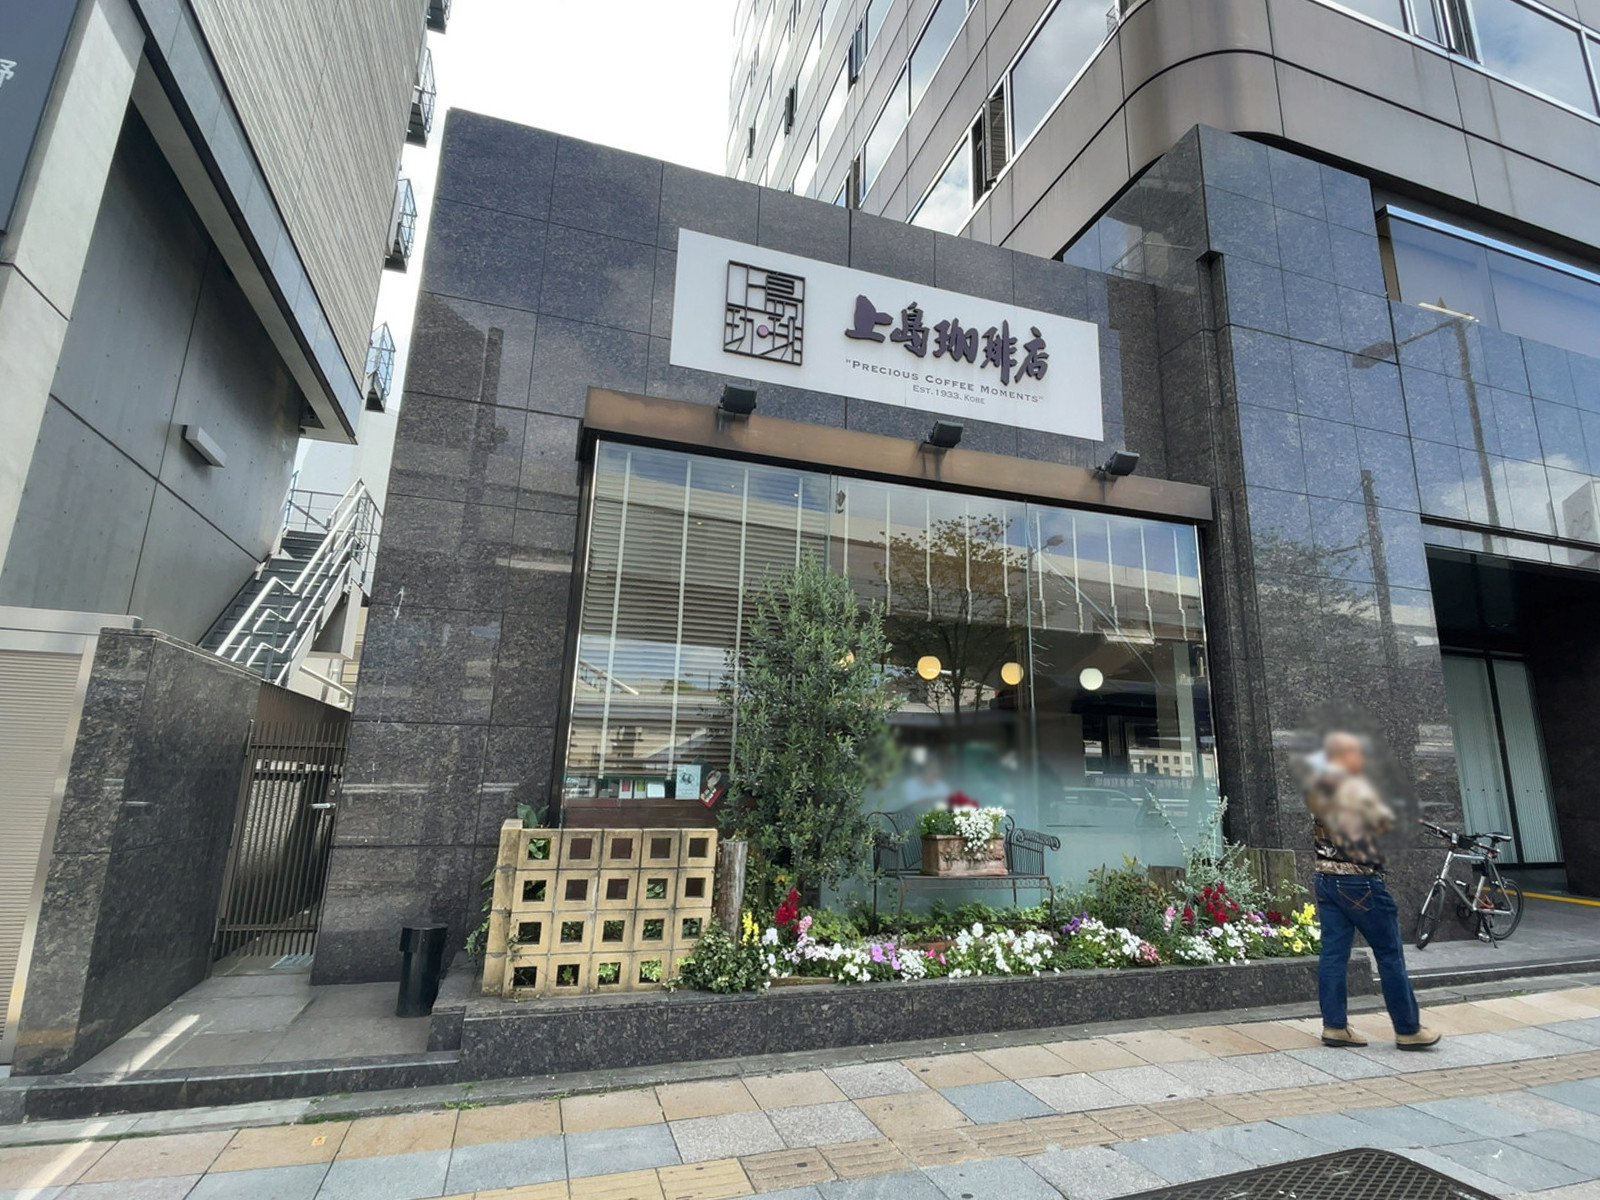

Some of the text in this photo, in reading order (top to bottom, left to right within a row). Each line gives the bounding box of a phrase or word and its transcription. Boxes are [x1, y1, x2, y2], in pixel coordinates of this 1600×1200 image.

[844, 294, 1050, 386] 上島珈琲店
[924, 374, 975, 392] COFFEE
